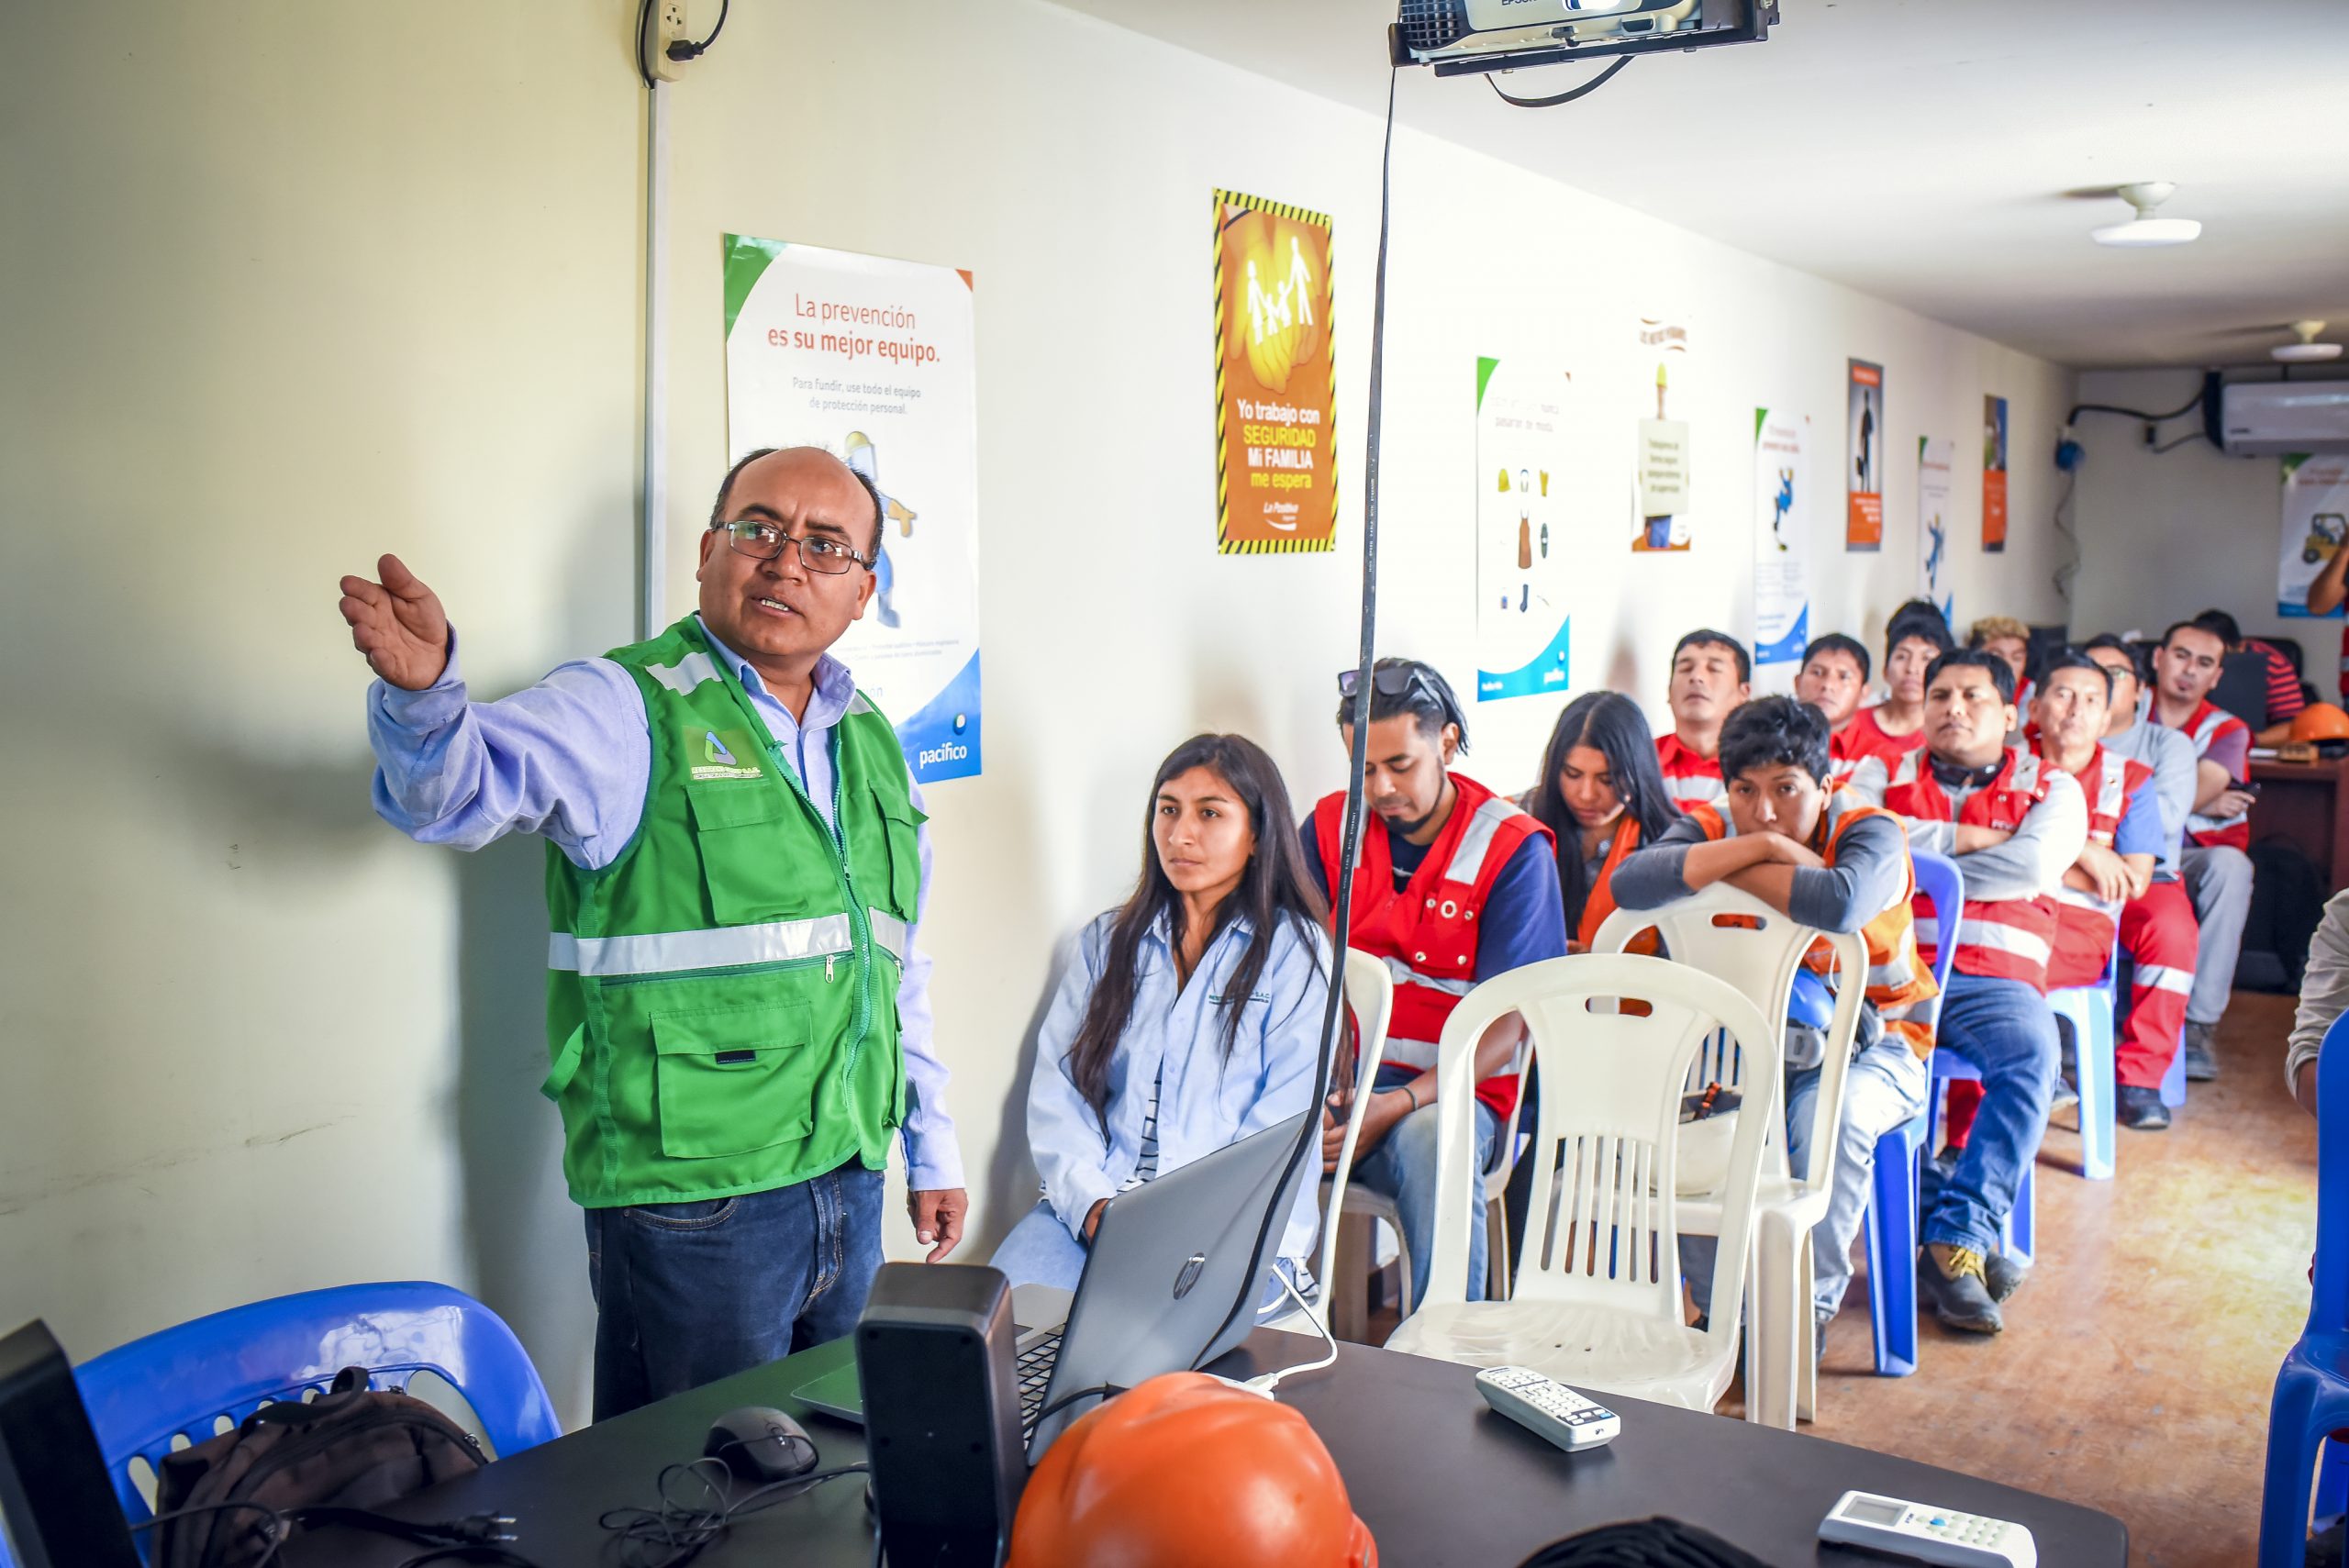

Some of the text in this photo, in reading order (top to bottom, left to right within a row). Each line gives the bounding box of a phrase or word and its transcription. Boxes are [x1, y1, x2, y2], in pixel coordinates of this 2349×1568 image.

[796, 293, 916, 329] La prevención
[768, 328, 941, 367] es su mejor equipo.
[793, 377, 813, 390] Para
[846, 384, 862, 394] use
[863, 383, 883, 395] todo
[885, 384, 892, 395] el
[894, 386, 921, 400] equipo
[809, 397, 820, 408] de
[822, 399, 868, 412] protección
[1236, 398, 1320, 427] Yo trabajo con
[1243, 425, 1316, 448] SEGURIDAD
[1264, 447, 1314, 470] FAMILIA
[1251, 473, 1312, 493] me espera
